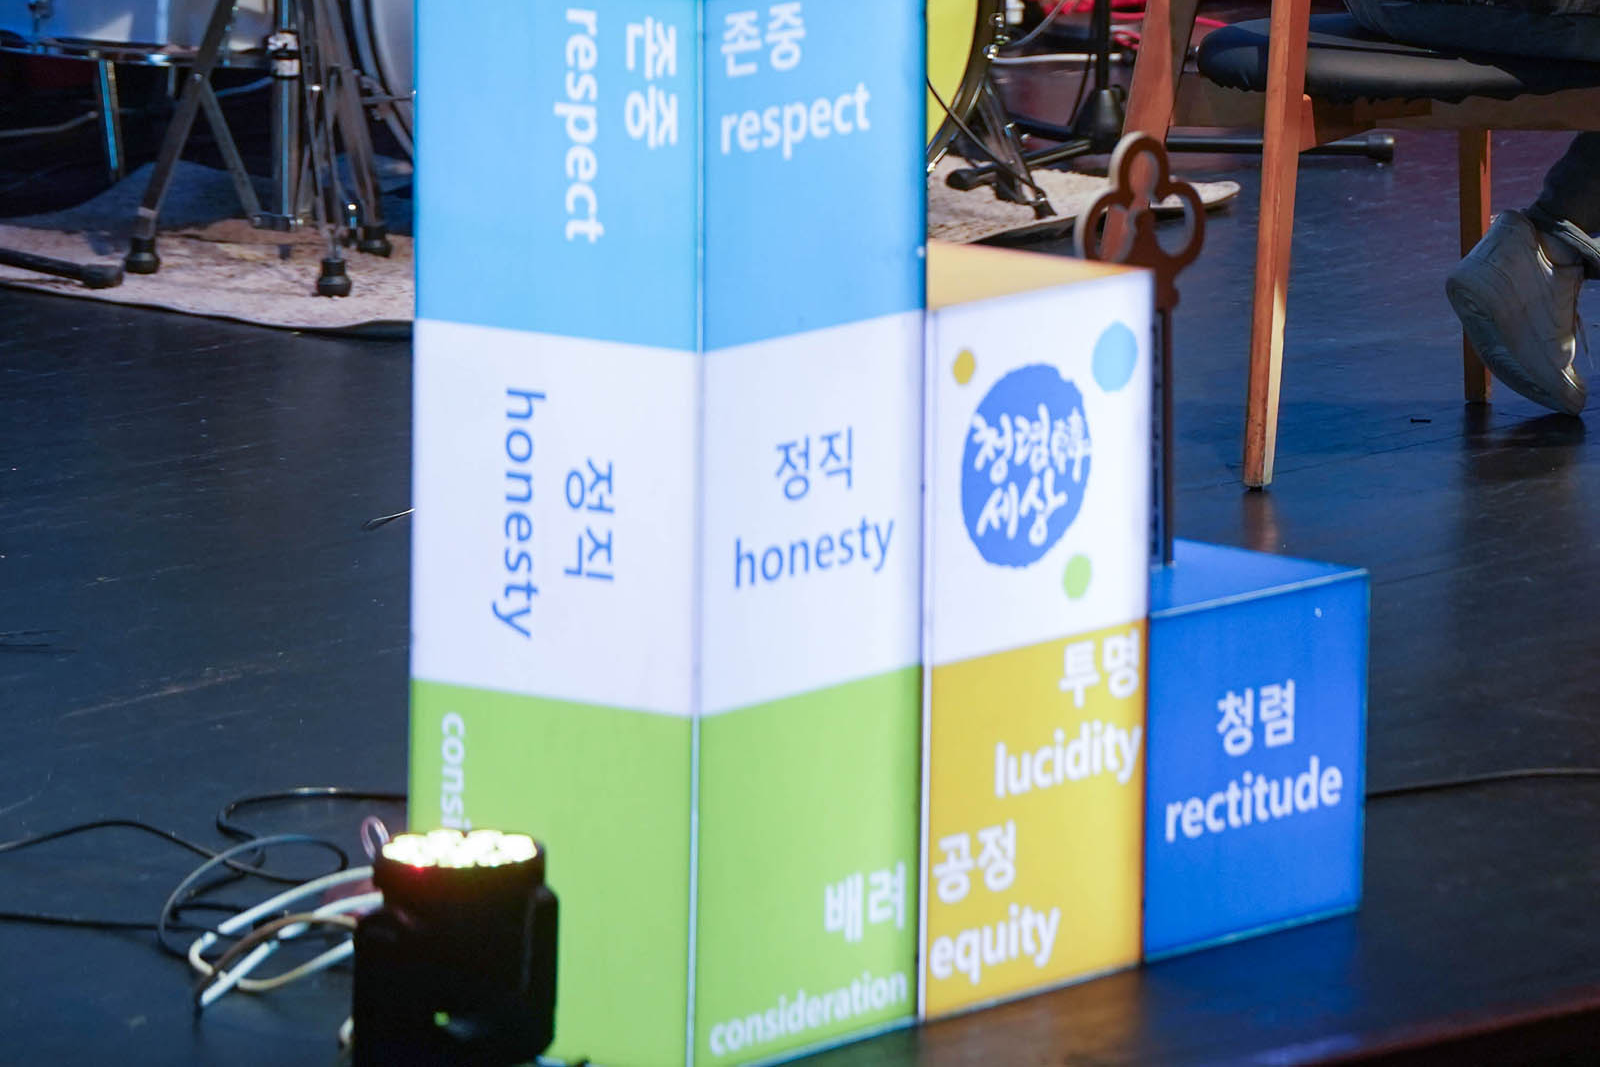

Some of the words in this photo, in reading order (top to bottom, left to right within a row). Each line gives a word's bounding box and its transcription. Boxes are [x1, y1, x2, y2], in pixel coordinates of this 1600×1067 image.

[721, 2, 806, 76] 존중
[625, 17, 677, 149] 존중
[722, 82, 870, 159] respect
[554, 9, 604, 242] respect
[775, 426, 853, 502] 정직
[492, 388, 546, 638] honesty
[564, 459, 614, 581] 정직
[976, 467, 1068, 547] 세상
[735, 518, 894, 589] honesty
[1058, 633, 1140, 708] 투명
[1217, 679, 1295, 756] 청렴
[995, 723, 1141, 798] lucidity
[1165, 756, 1343, 841] rectitude
[932, 819, 1018, 904] 공정
[824, 862, 904, 942] 배려
[930, 906, 1061, 984] equity
[709, 970, 907, 1056] consideration
